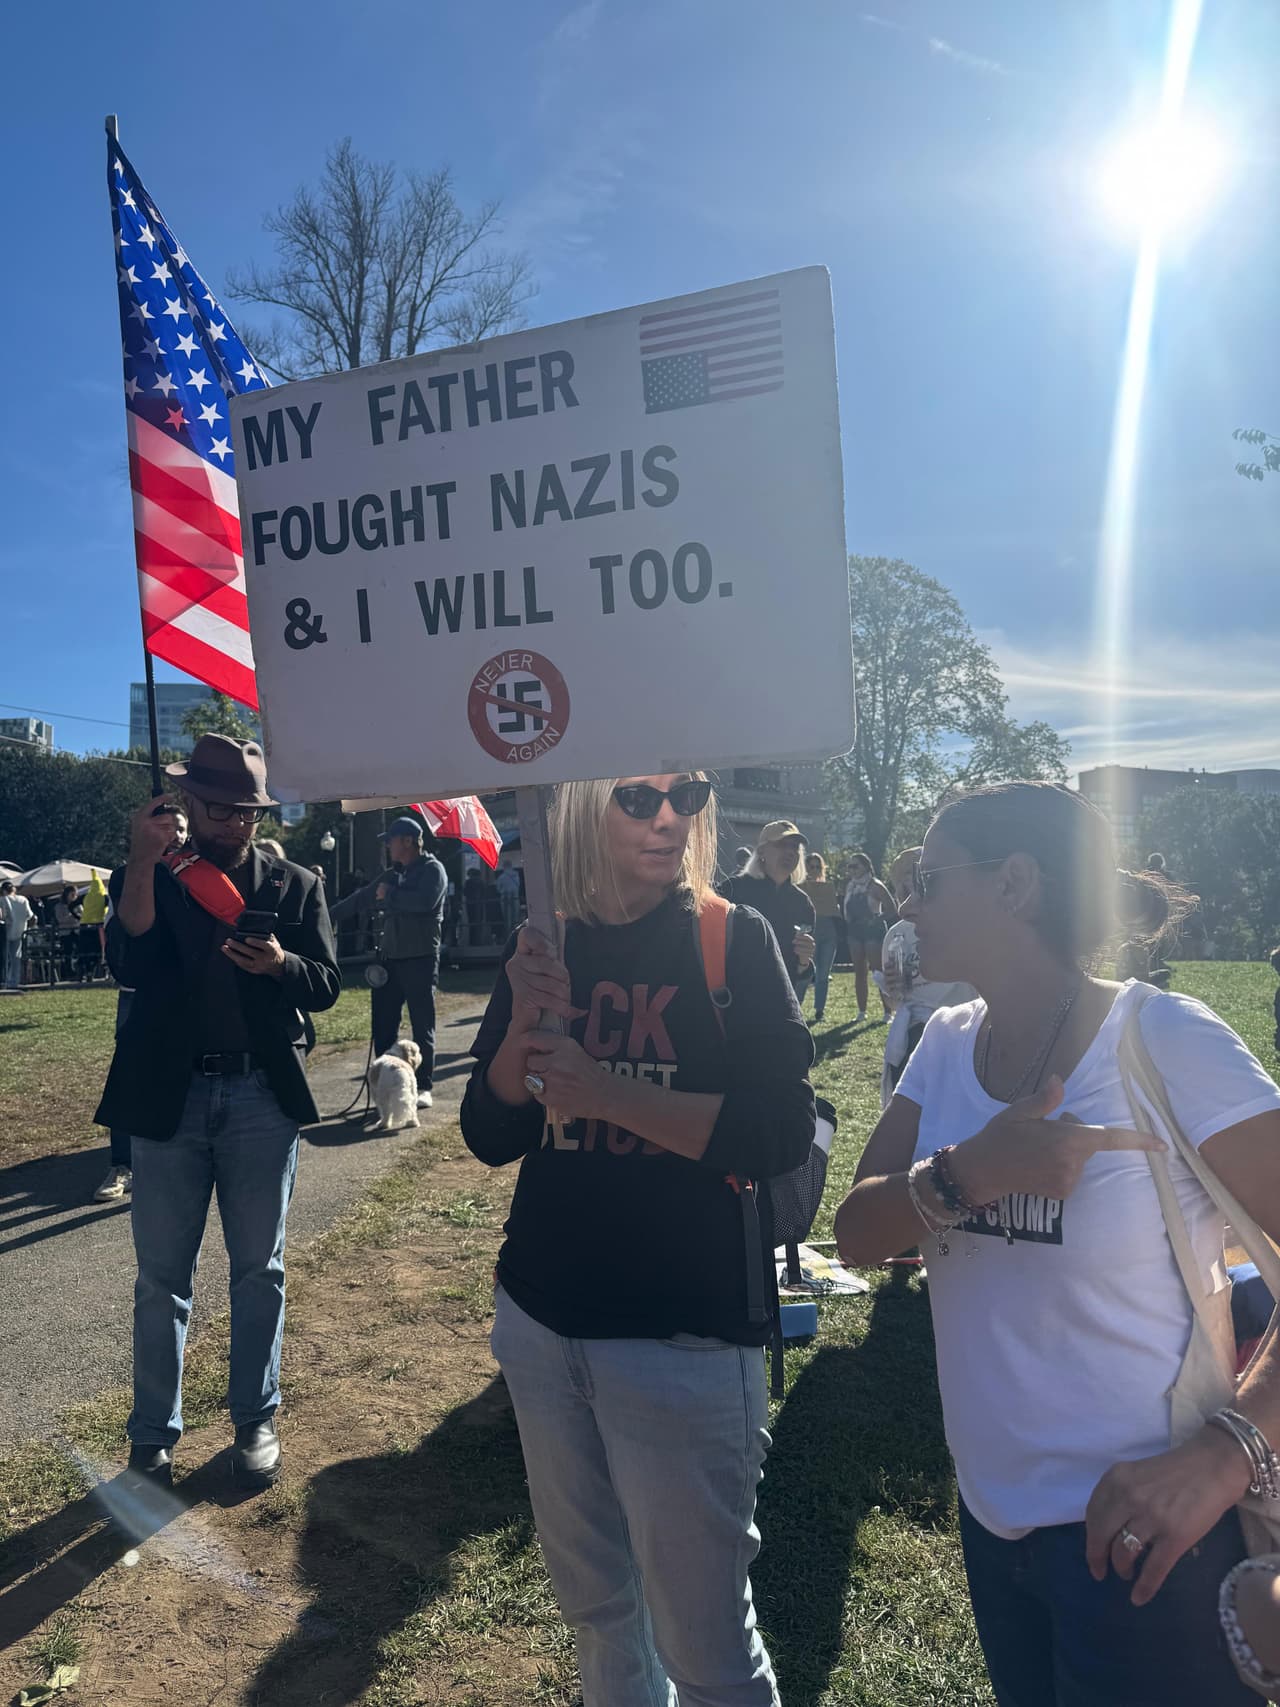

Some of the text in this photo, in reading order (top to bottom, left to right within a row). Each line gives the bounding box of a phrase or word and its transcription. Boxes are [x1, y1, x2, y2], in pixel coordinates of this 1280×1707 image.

[242, 350, 579, 470] MY FATHER
[252, 445, 680, 566] FOUGHT NAZIS
[284, 542, 734, 650] & I WILL TOO.
[475, 653, 534, 694] NEVER
[506, 726, 561, 761] AGAIN
